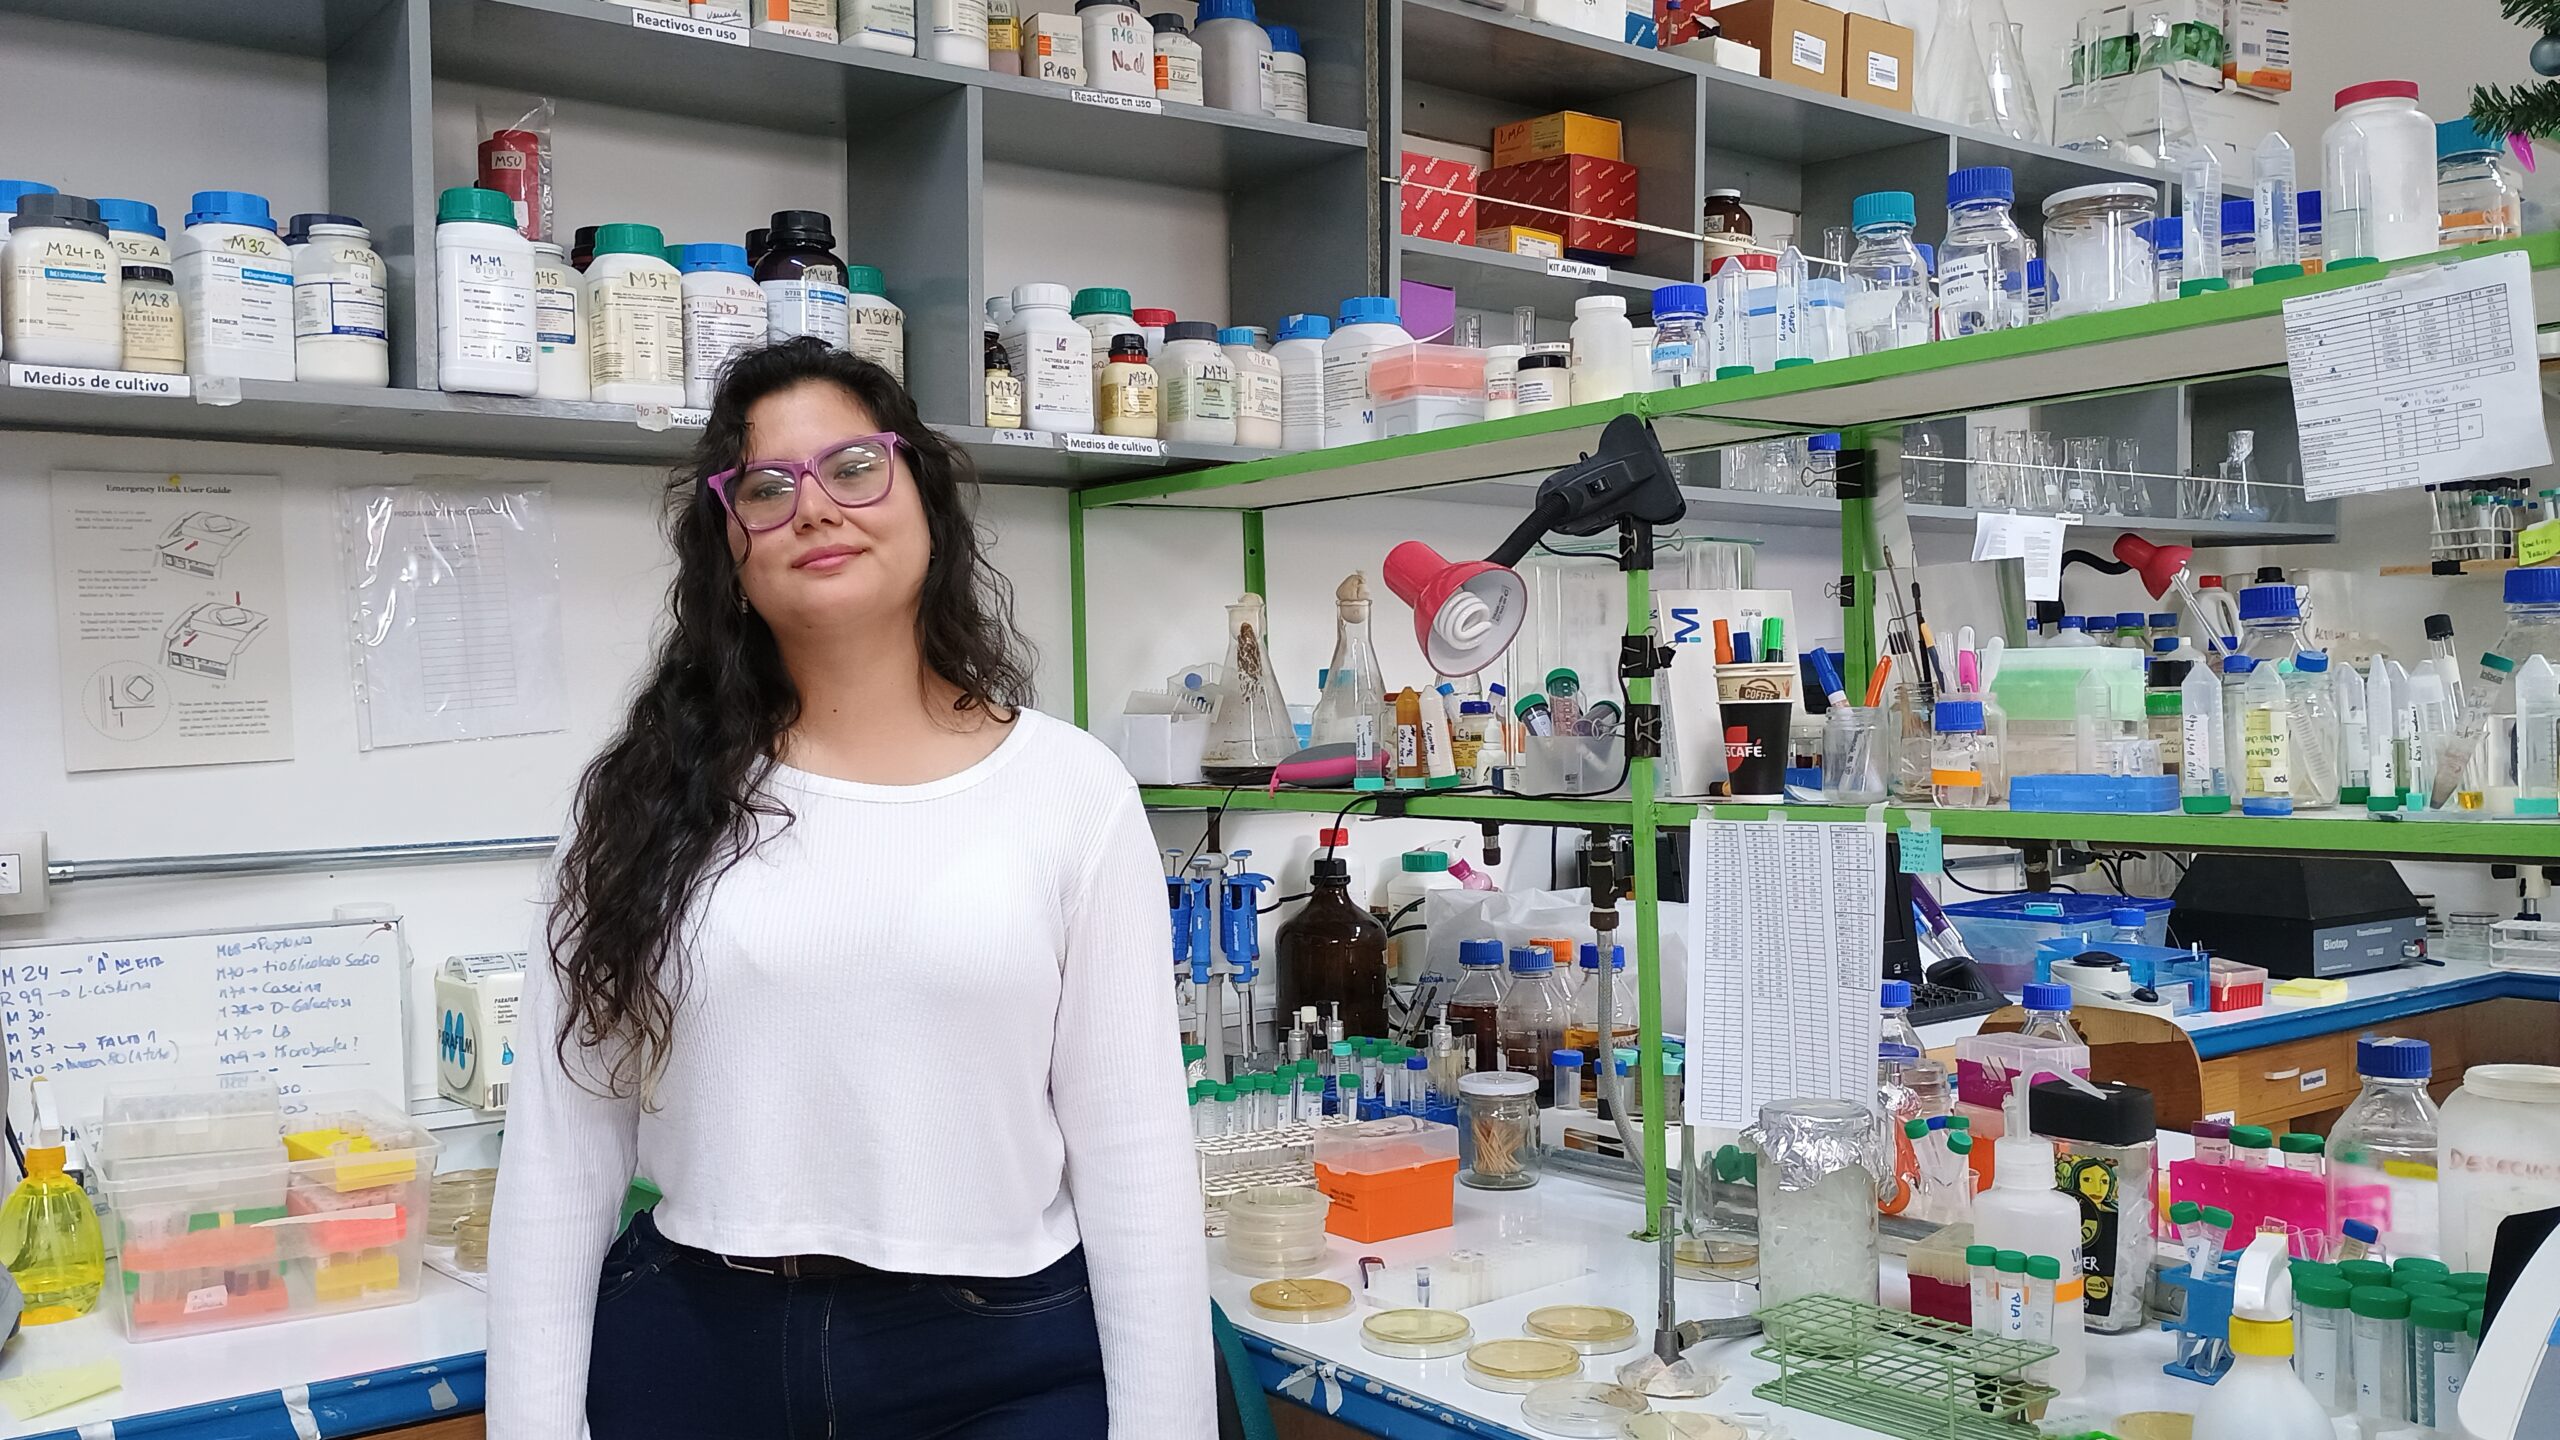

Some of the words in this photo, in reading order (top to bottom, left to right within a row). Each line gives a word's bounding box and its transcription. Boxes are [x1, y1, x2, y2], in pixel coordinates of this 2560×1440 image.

[636, 13, 695, 33] Reactivos
[697, 24, 713, 36] en
[715, 29, 737, 41] uso
[1074, 91, 1120, 106] Reactivos
[1121, 96, 1133, 107] en
[1134, 99, 1152, 109] uso
[1431, 208, 1450, 232] QIAGEN
[45, 241, 105, 260] M24-B
[230, 235, 272, 257] M32
[1548, 263, 1560, 273] KIT
[1561, 264, 1577, 275] ADN
[1577, 265, 1597, 277] /ARN
[629, 271, 669, 291] M57
[131, 291, 171, 309] M28
[24, 370, 86, 388] Medios
[90, 374, 112, 389] de
[115, 376, 170, 394] cultivo
[1362, 410, 1374, 424] M
[1070, 438, 1106, 451] Medios
[1107, 440, 1120, 451] de
[1121, 441, 1153, 454] cultivo
[106, 484, 155, 494] Emergency
[157, 486, 182, 494] Hook
[183, 486, 204, 494] User
[205, 486, 232, 495] Guide
[1744, 687, 1776, 700] COFFEE
